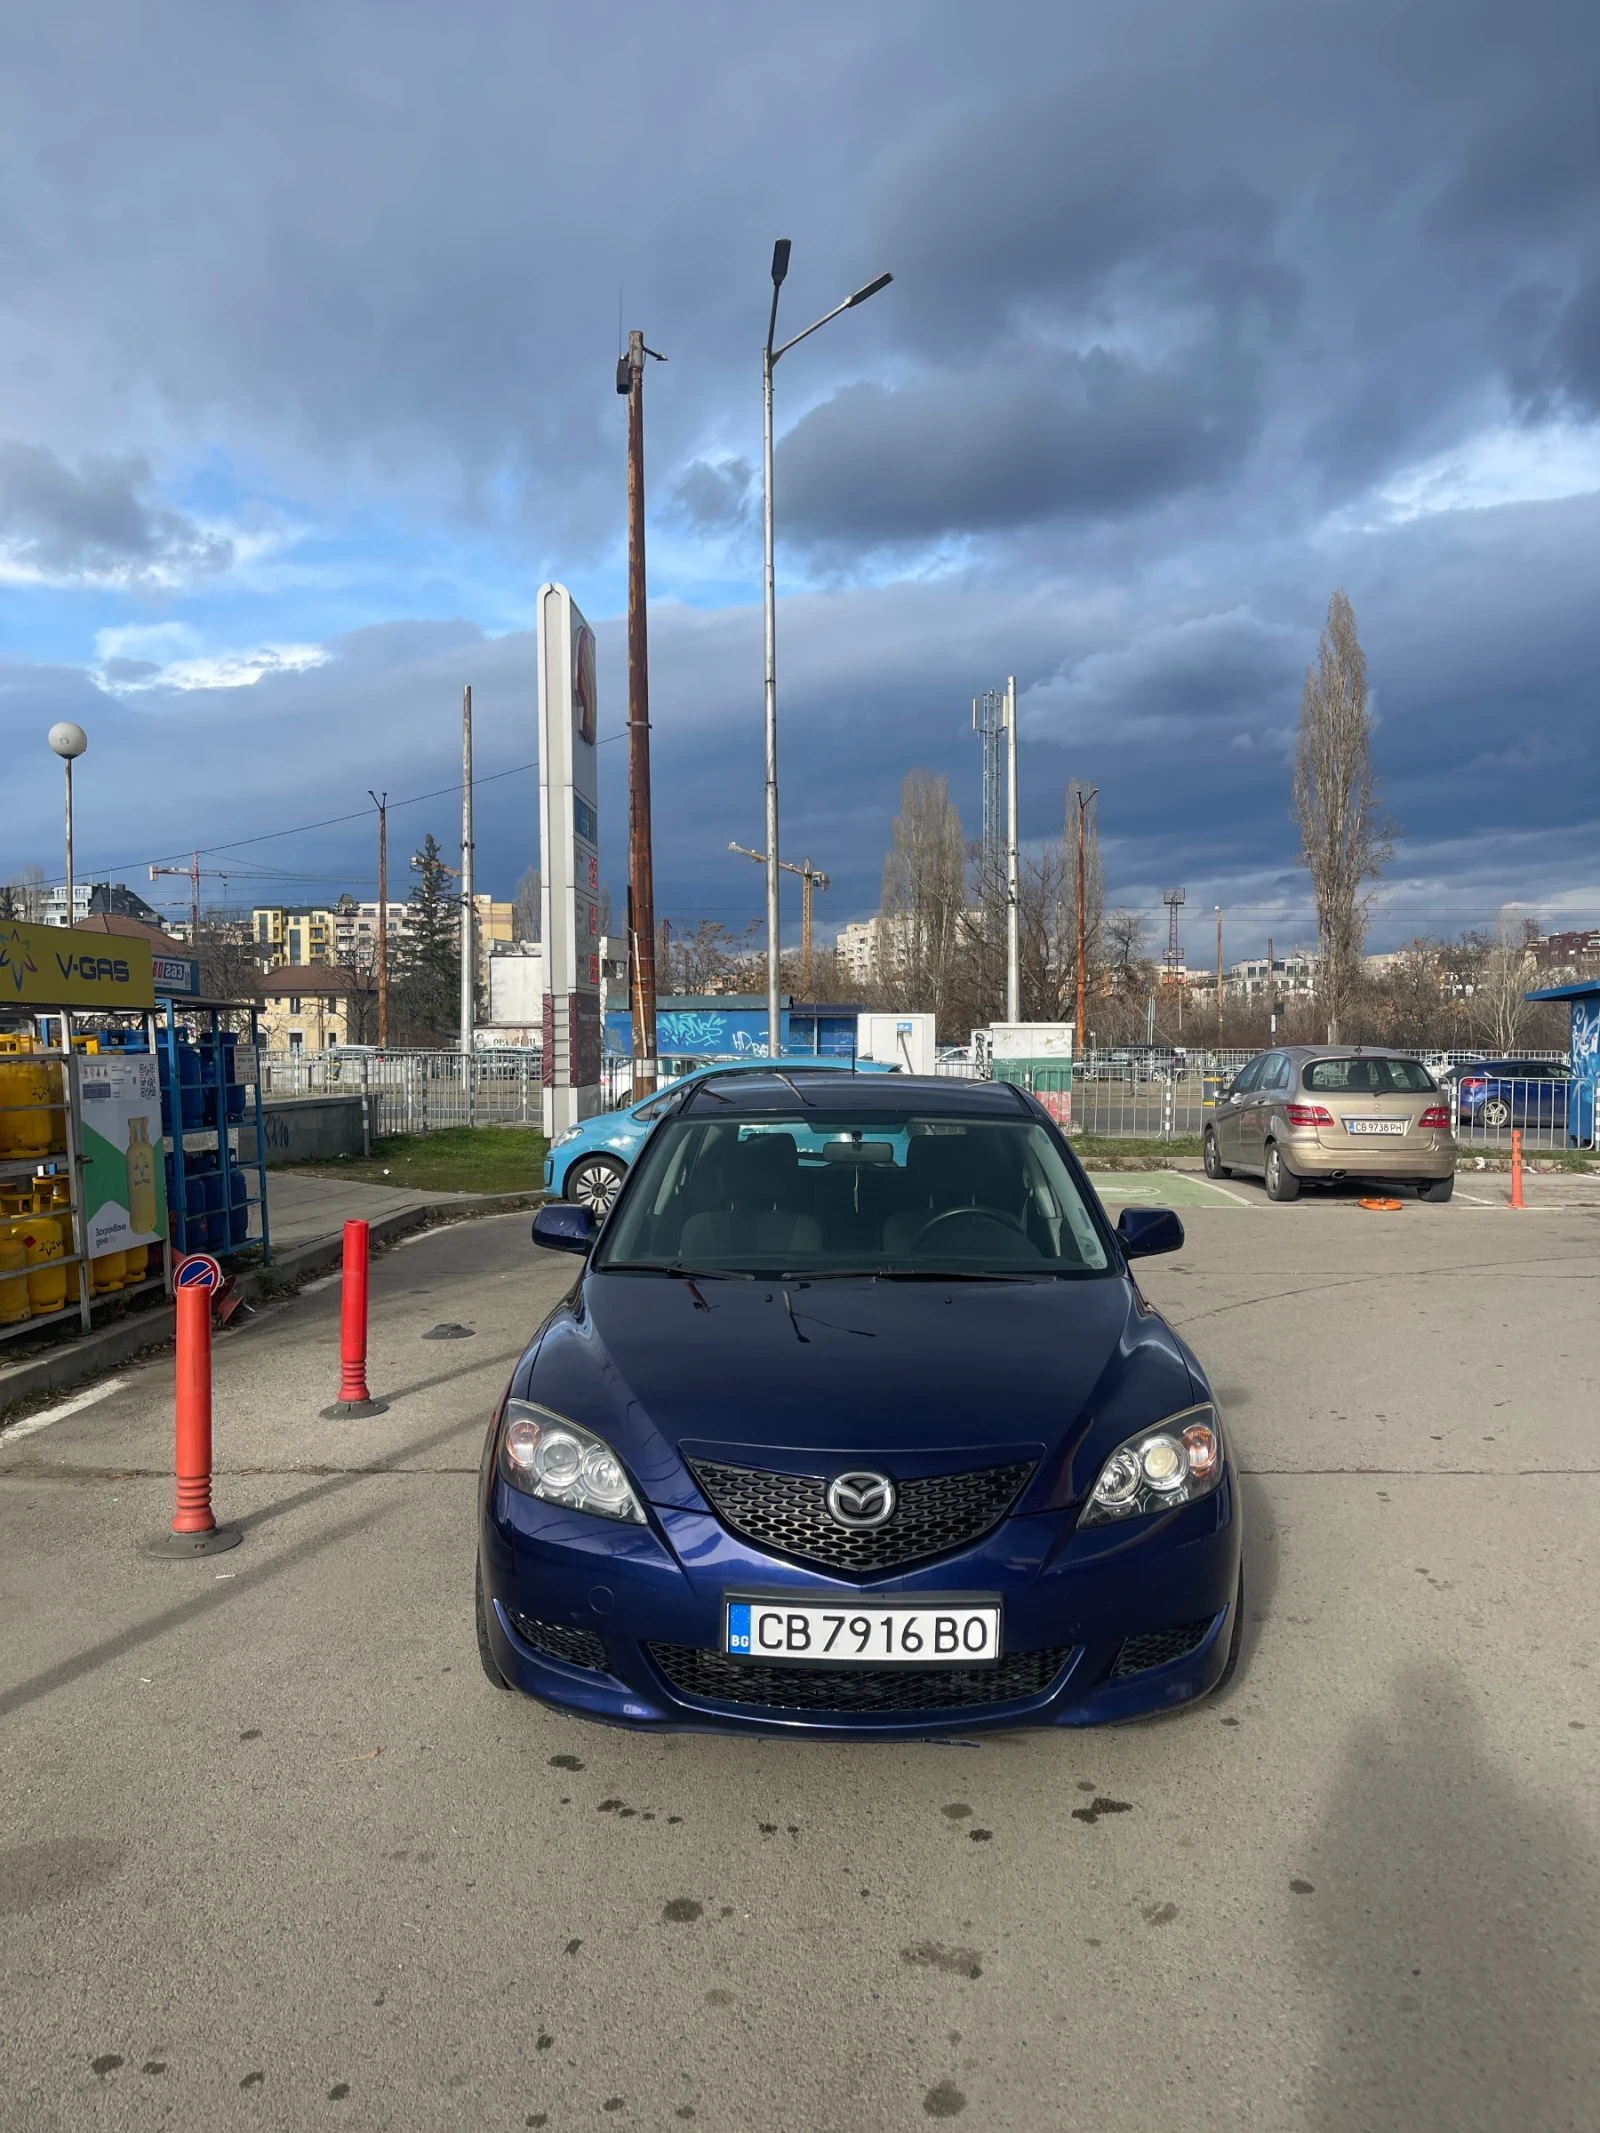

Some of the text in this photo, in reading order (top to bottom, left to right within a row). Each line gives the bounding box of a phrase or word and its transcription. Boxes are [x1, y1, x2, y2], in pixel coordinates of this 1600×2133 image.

[1368, 1123, 1389, 1132] 9738
[730, 1634, 749, 1648] BG
[757, 1613, 812, 1651] CB
[822, 1615, 925, 1653] 7916
